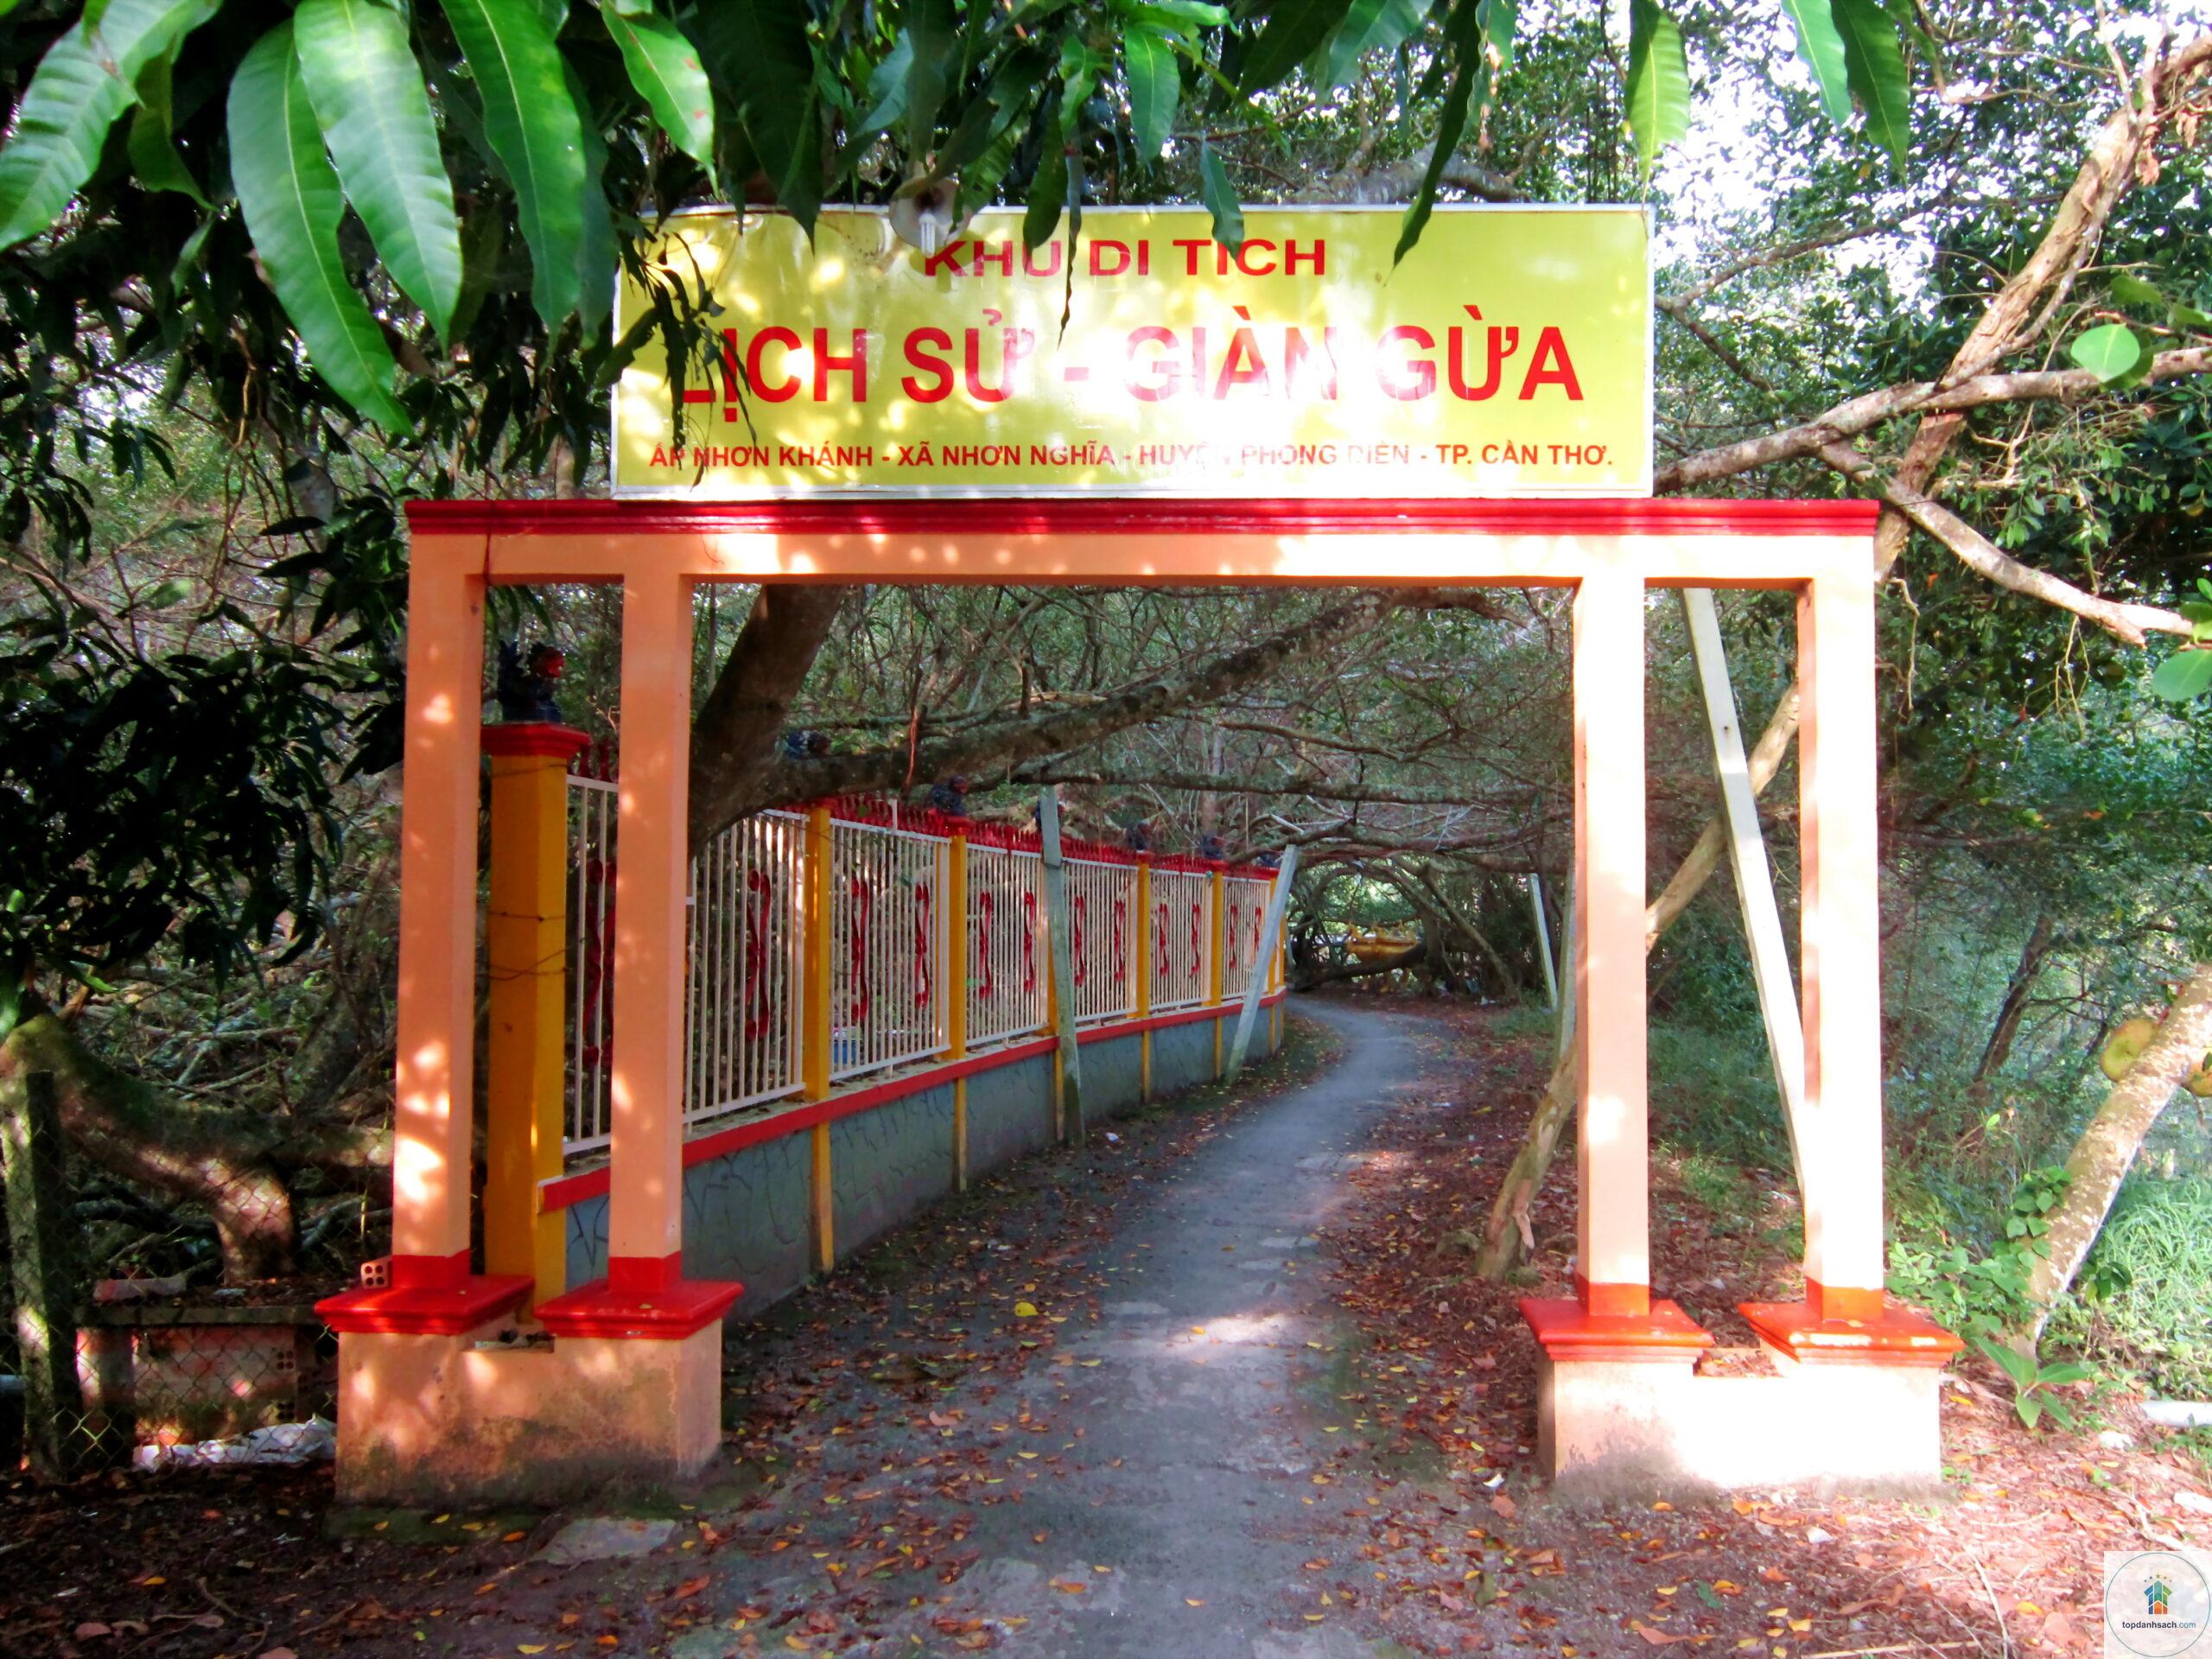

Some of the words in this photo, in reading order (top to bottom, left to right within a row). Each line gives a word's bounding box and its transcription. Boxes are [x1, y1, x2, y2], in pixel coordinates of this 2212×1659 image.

[925, 239, 1062, 276] KHU
[1090, 239, 1149, 276] DI
[901, 308, 1035, 404] SỬ
[1064, 367, 1090, 381] -
[1375, 304, 1584, 402] GỪA
[693, 445, 770, 467] NHƠN
[779, 440, 873, 467] KHÁNH
[898, 441, 935, 467] XÃ
[943, 445, 1021, 467] NHƠN
[1030, 440, 1116, 466] NGHĨA
[1139, 442, 1231, 467] HUY
[1434, 444, 1472, 466] TP.
[1547, 444, 1614, 466] THƠ.
